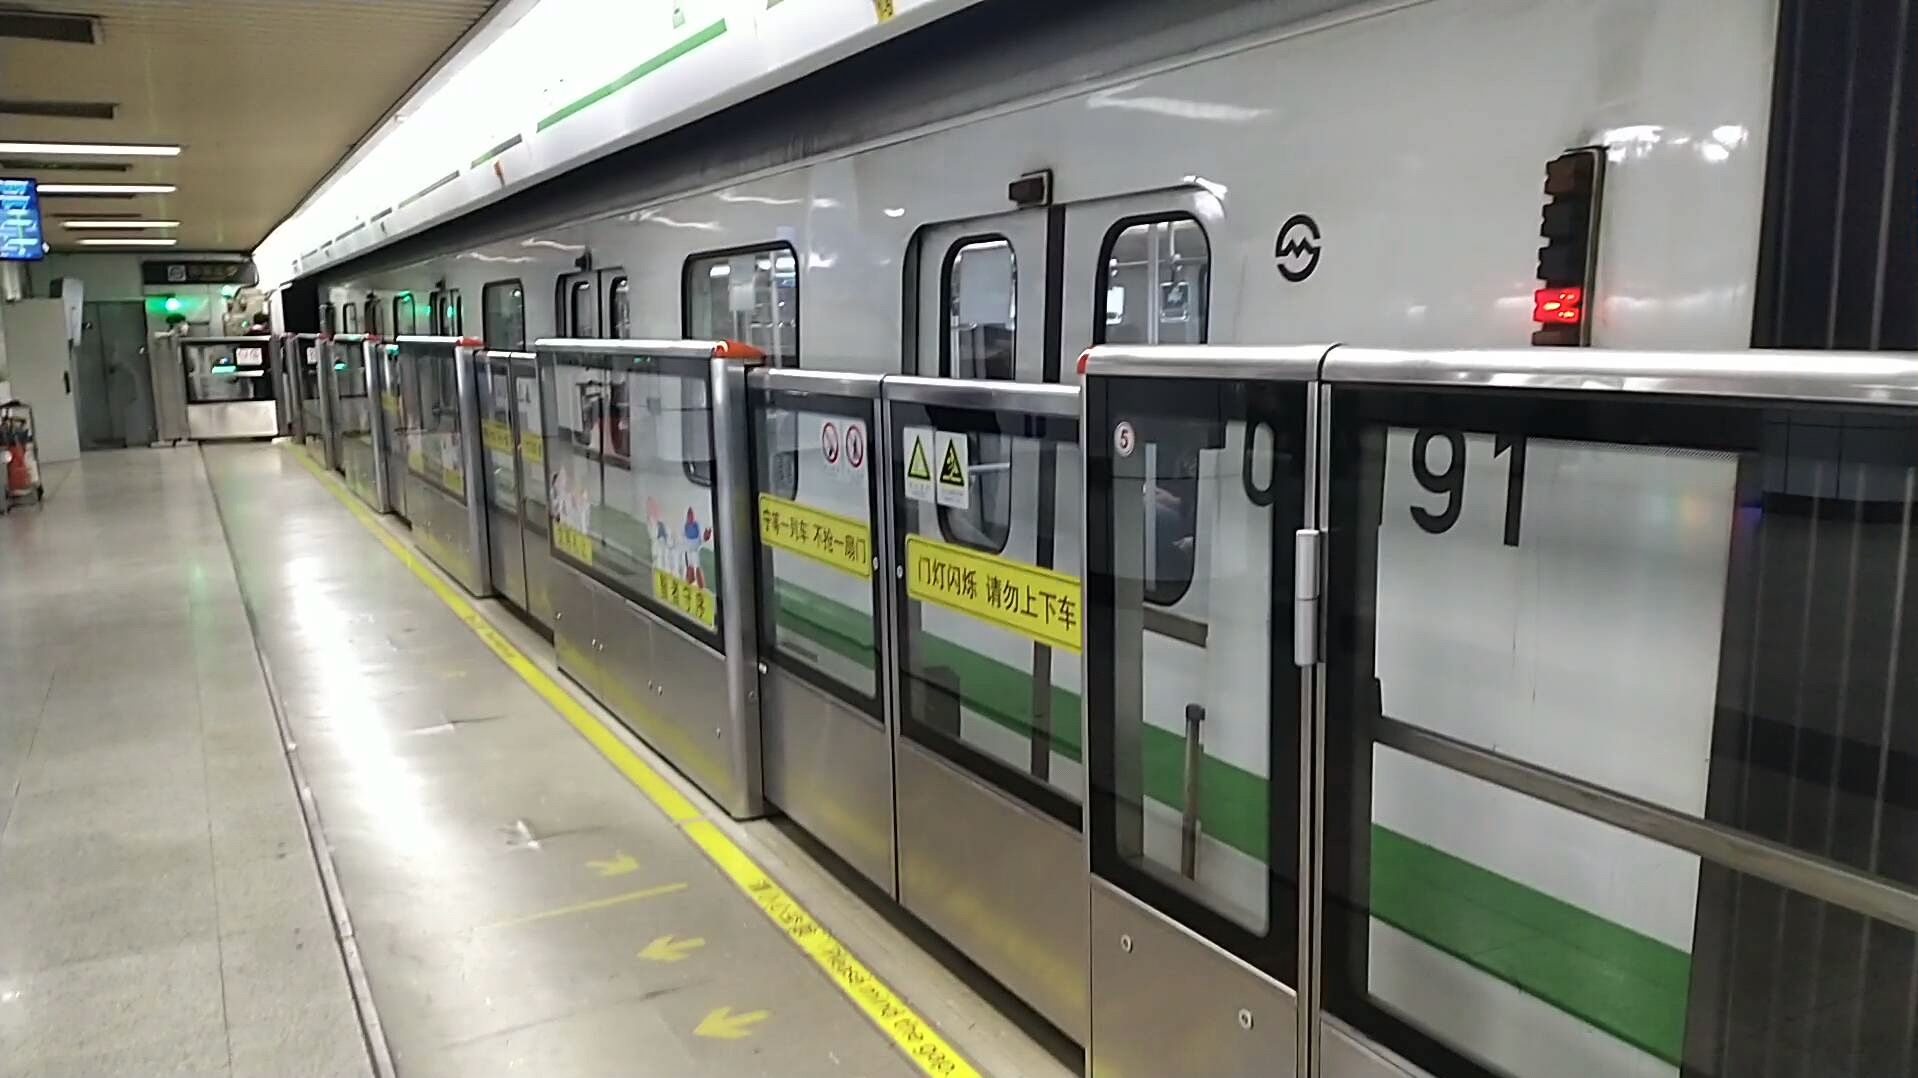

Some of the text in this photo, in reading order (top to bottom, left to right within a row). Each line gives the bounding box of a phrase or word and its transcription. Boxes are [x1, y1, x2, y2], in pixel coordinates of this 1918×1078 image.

[917, 553, 1077, 632] 门灯闪烁 请勿上下车
